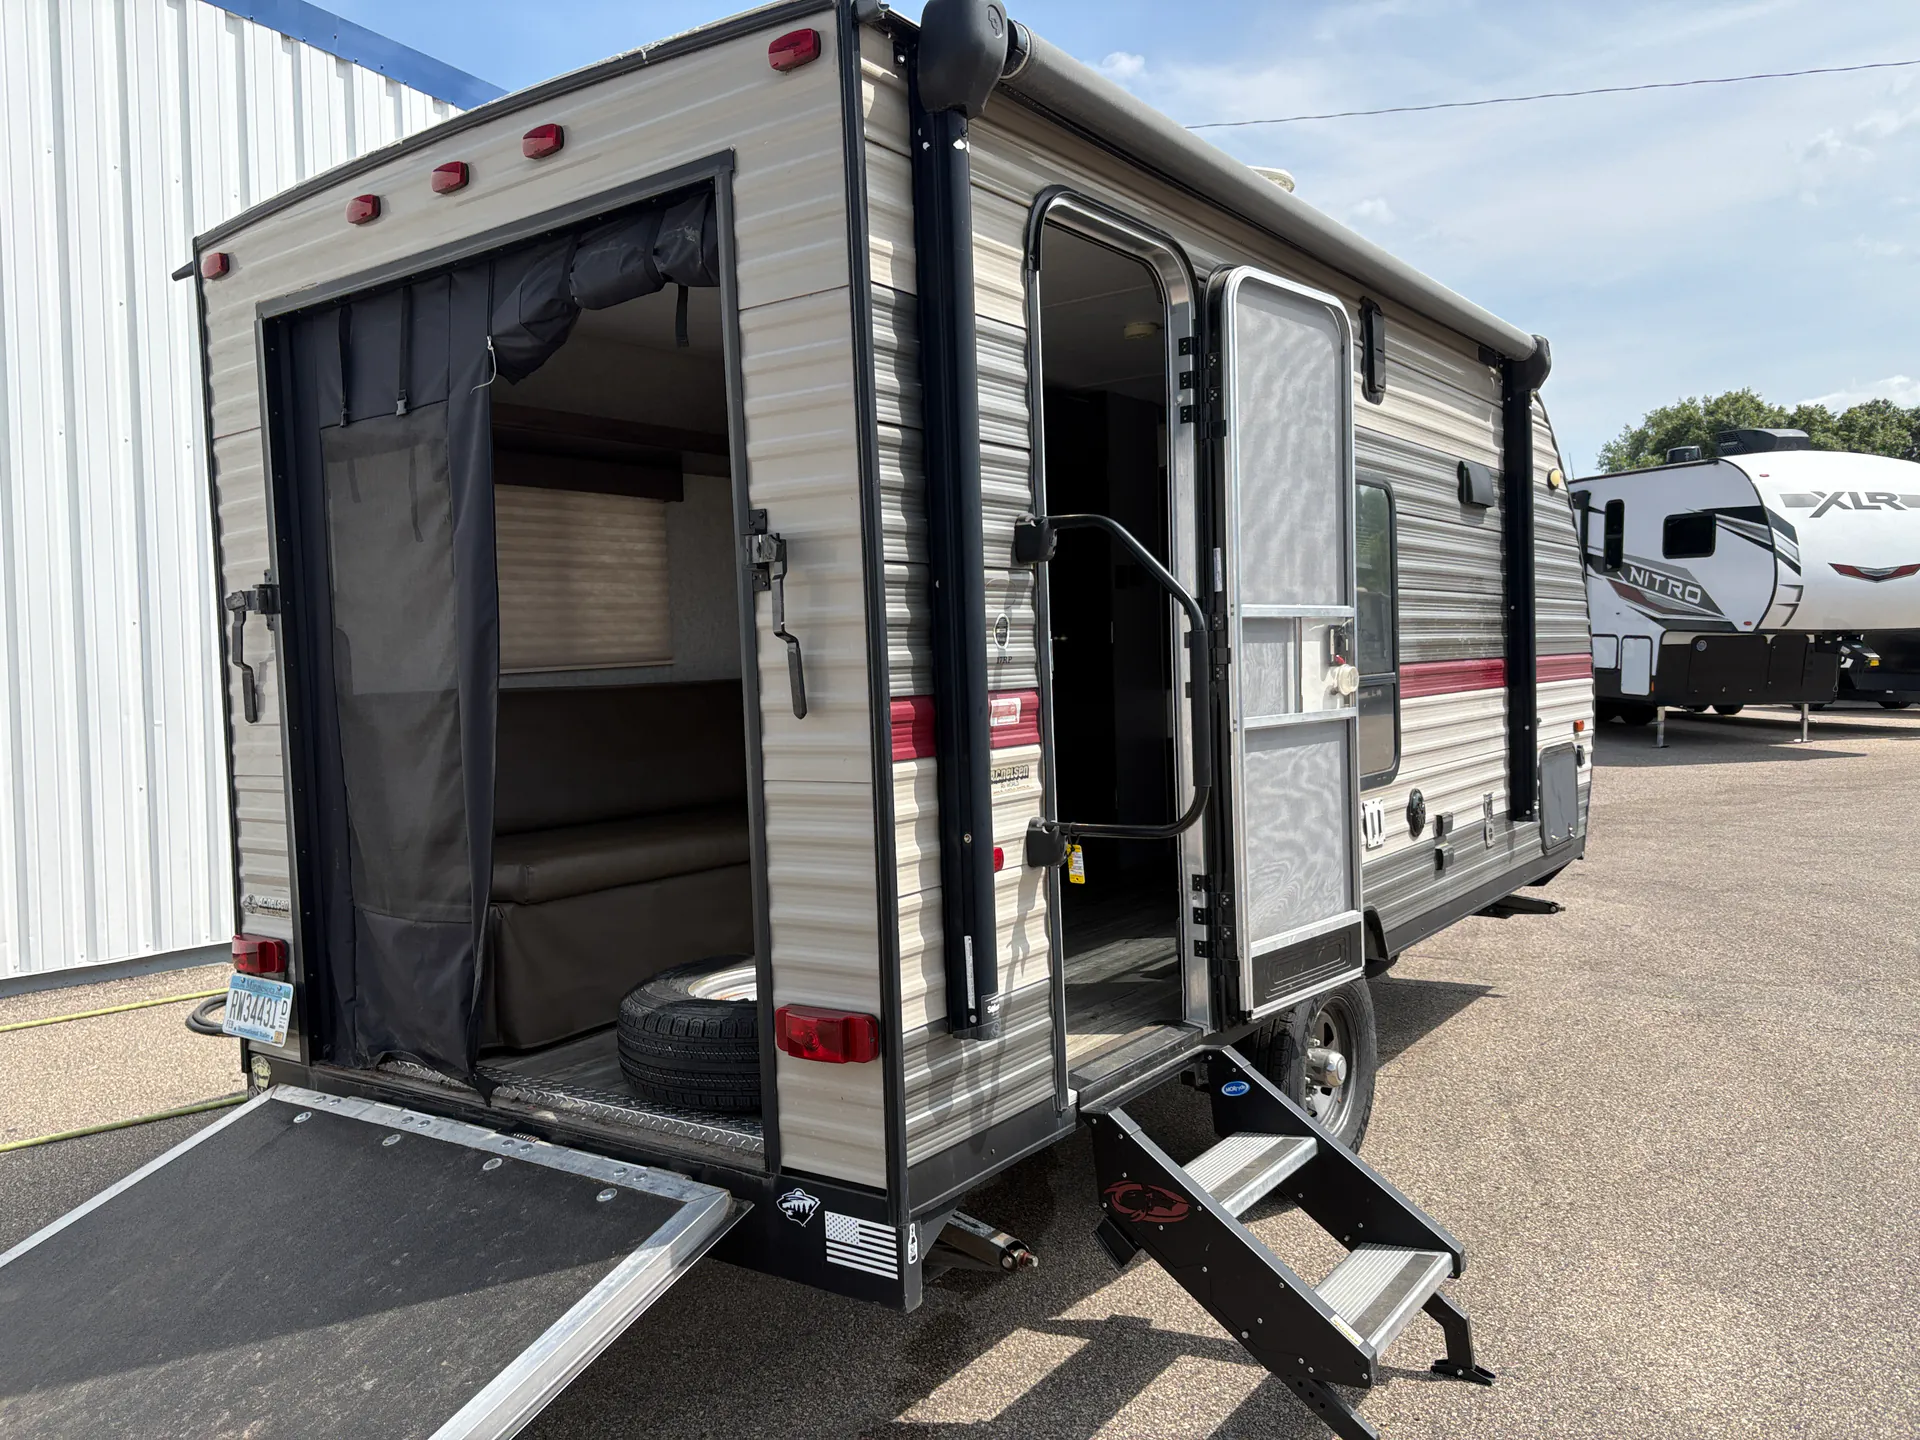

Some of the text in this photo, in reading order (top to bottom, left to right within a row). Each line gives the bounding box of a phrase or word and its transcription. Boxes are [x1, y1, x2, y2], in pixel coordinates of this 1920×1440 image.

[1808, 491, 1907, 518] XLR
[1629, 566, 1701, 604] NITRO
[230, 990, 277, 1030] RW34431
